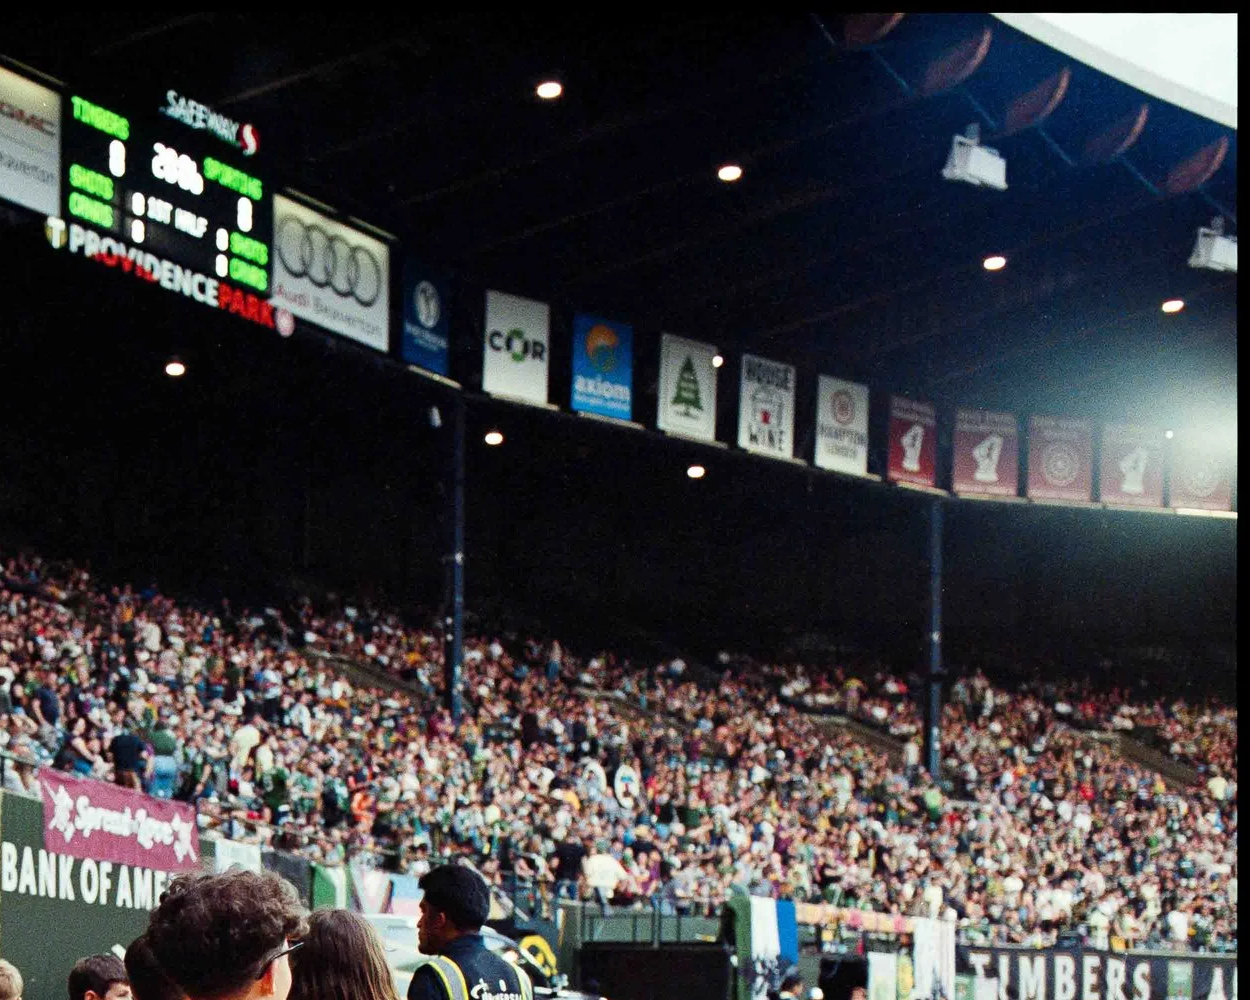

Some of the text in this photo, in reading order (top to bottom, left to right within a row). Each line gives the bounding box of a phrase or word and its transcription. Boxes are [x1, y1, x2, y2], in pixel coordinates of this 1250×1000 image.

[160, 89, 239, 143] SAFEWAY
[69, 223, 276, 329] PROVIDENCE PARK
[276, 284, 310, 308] Audi
[488, 328, 546, 362] COR
[574, 374, 630, 401] axiom
[745, 359, 793, 390] HOUSE
[749, 422, 784, 452] WINE
[1, 841, 178, 912] BANK OF AME
